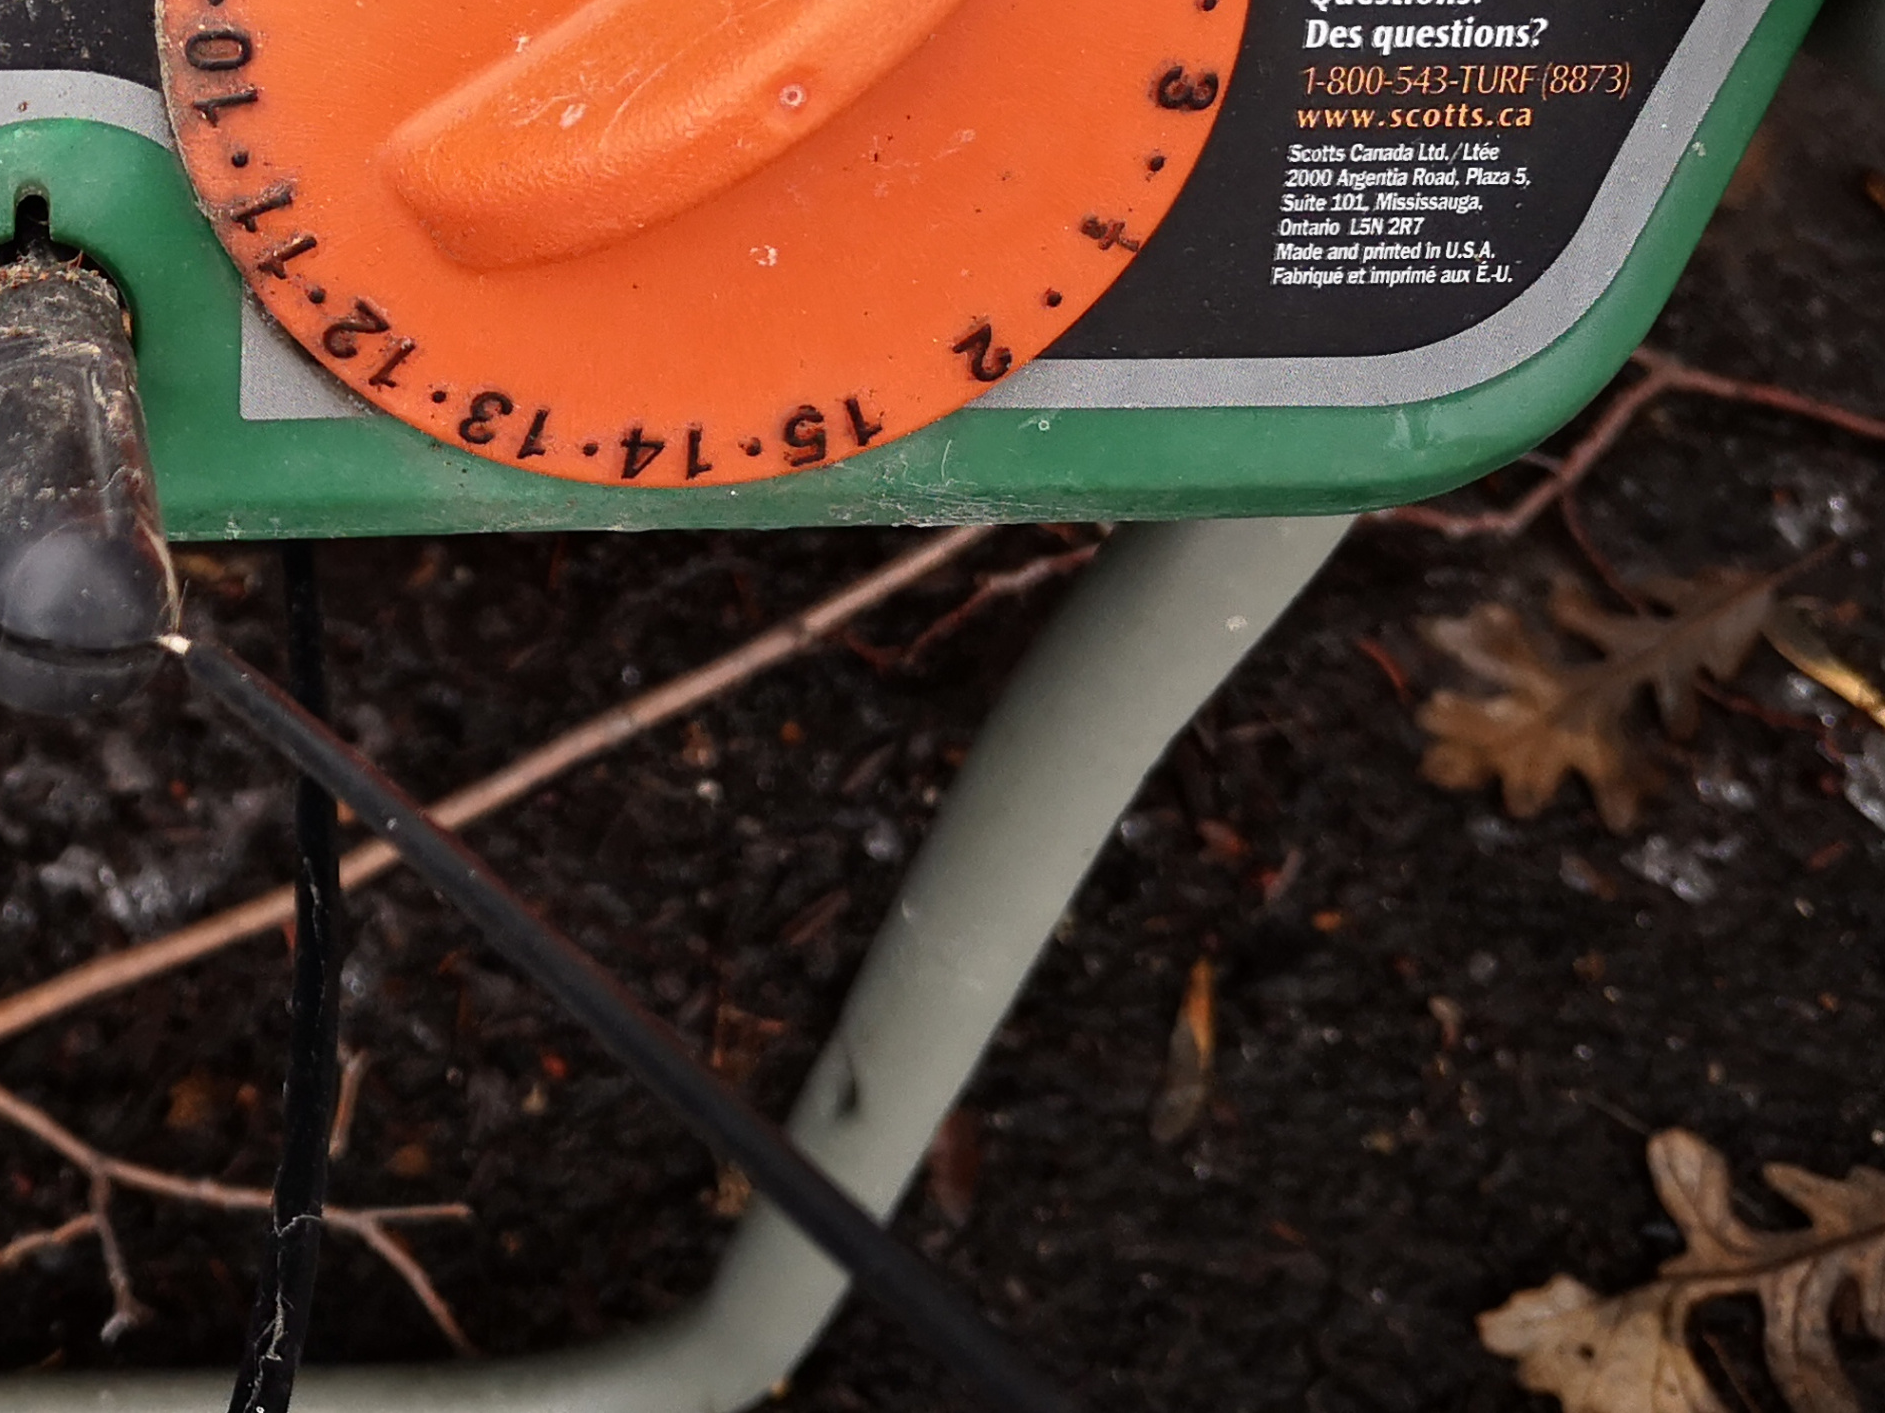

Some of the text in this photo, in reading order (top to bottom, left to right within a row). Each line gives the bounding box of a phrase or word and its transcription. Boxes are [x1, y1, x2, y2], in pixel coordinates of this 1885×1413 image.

[1302, 17, 1549, 56] Des questions?
[183, 25, 258, 129] 10
[1154, 64, 1220, 114] 3
[1300, 61, 1631, 101] 1-800-543-TURF (8873)
[1297, 103, 1534, 129] www.scotts.ca
[1287, 143, 1414, 163] Scotts Canada
[1283, 167, 1510, 190] 2000 Argentia Road, Plaza
[1280, 193, 1327, 212] Suite
[226, 189, 317, 282] 11
[1278, 217, 1425, 236] Ontario L5N 2R7
[1274, 240, 1496, 263] Made and printed U.S.A.
[1271, 266, 1344, 287] Fabriqué
[1370, 265, 1436, 286] imprimé
[319, 296, 418, 388] 12
[952, 320, 1011, 383] 2
[455, 387, 550, 460] 13
[784, 397, 883, 465] 15
[620, 423, 713, 484] 14
